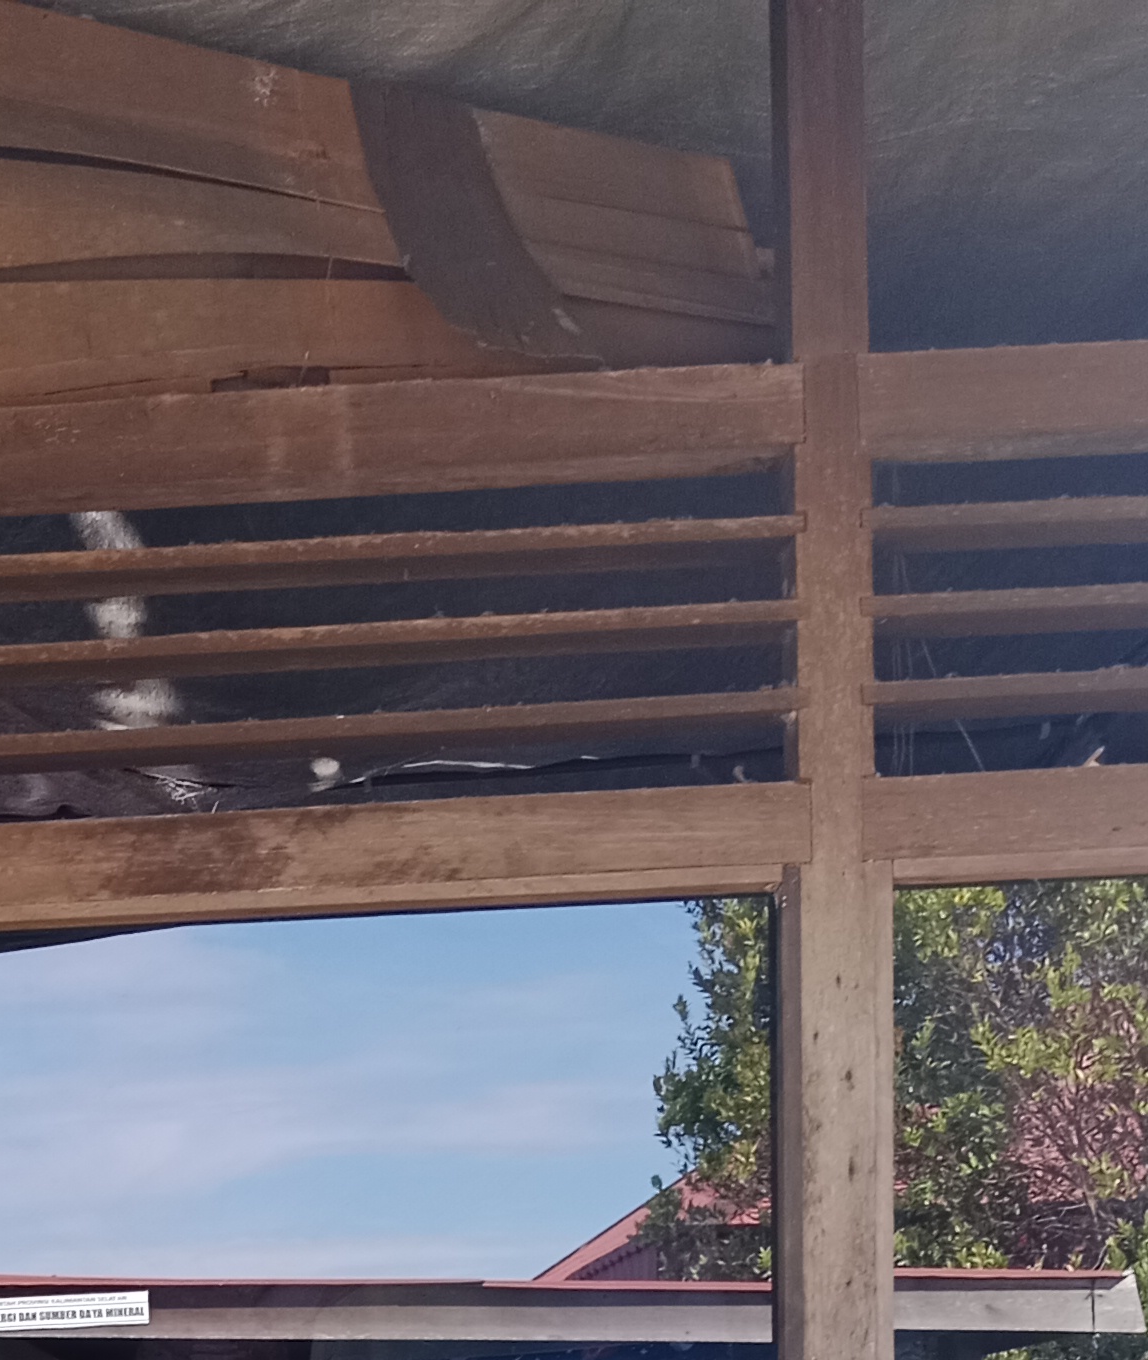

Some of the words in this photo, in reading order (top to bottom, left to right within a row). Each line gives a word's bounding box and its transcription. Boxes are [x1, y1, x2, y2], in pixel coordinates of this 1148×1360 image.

[18, 1312, 37, 1322] DAN
[39, 1310, 77, 1321] SUMBER
[79, 1309, 103, 1319] DAYA
[105, 1307, 144, 1318] MINERAL
